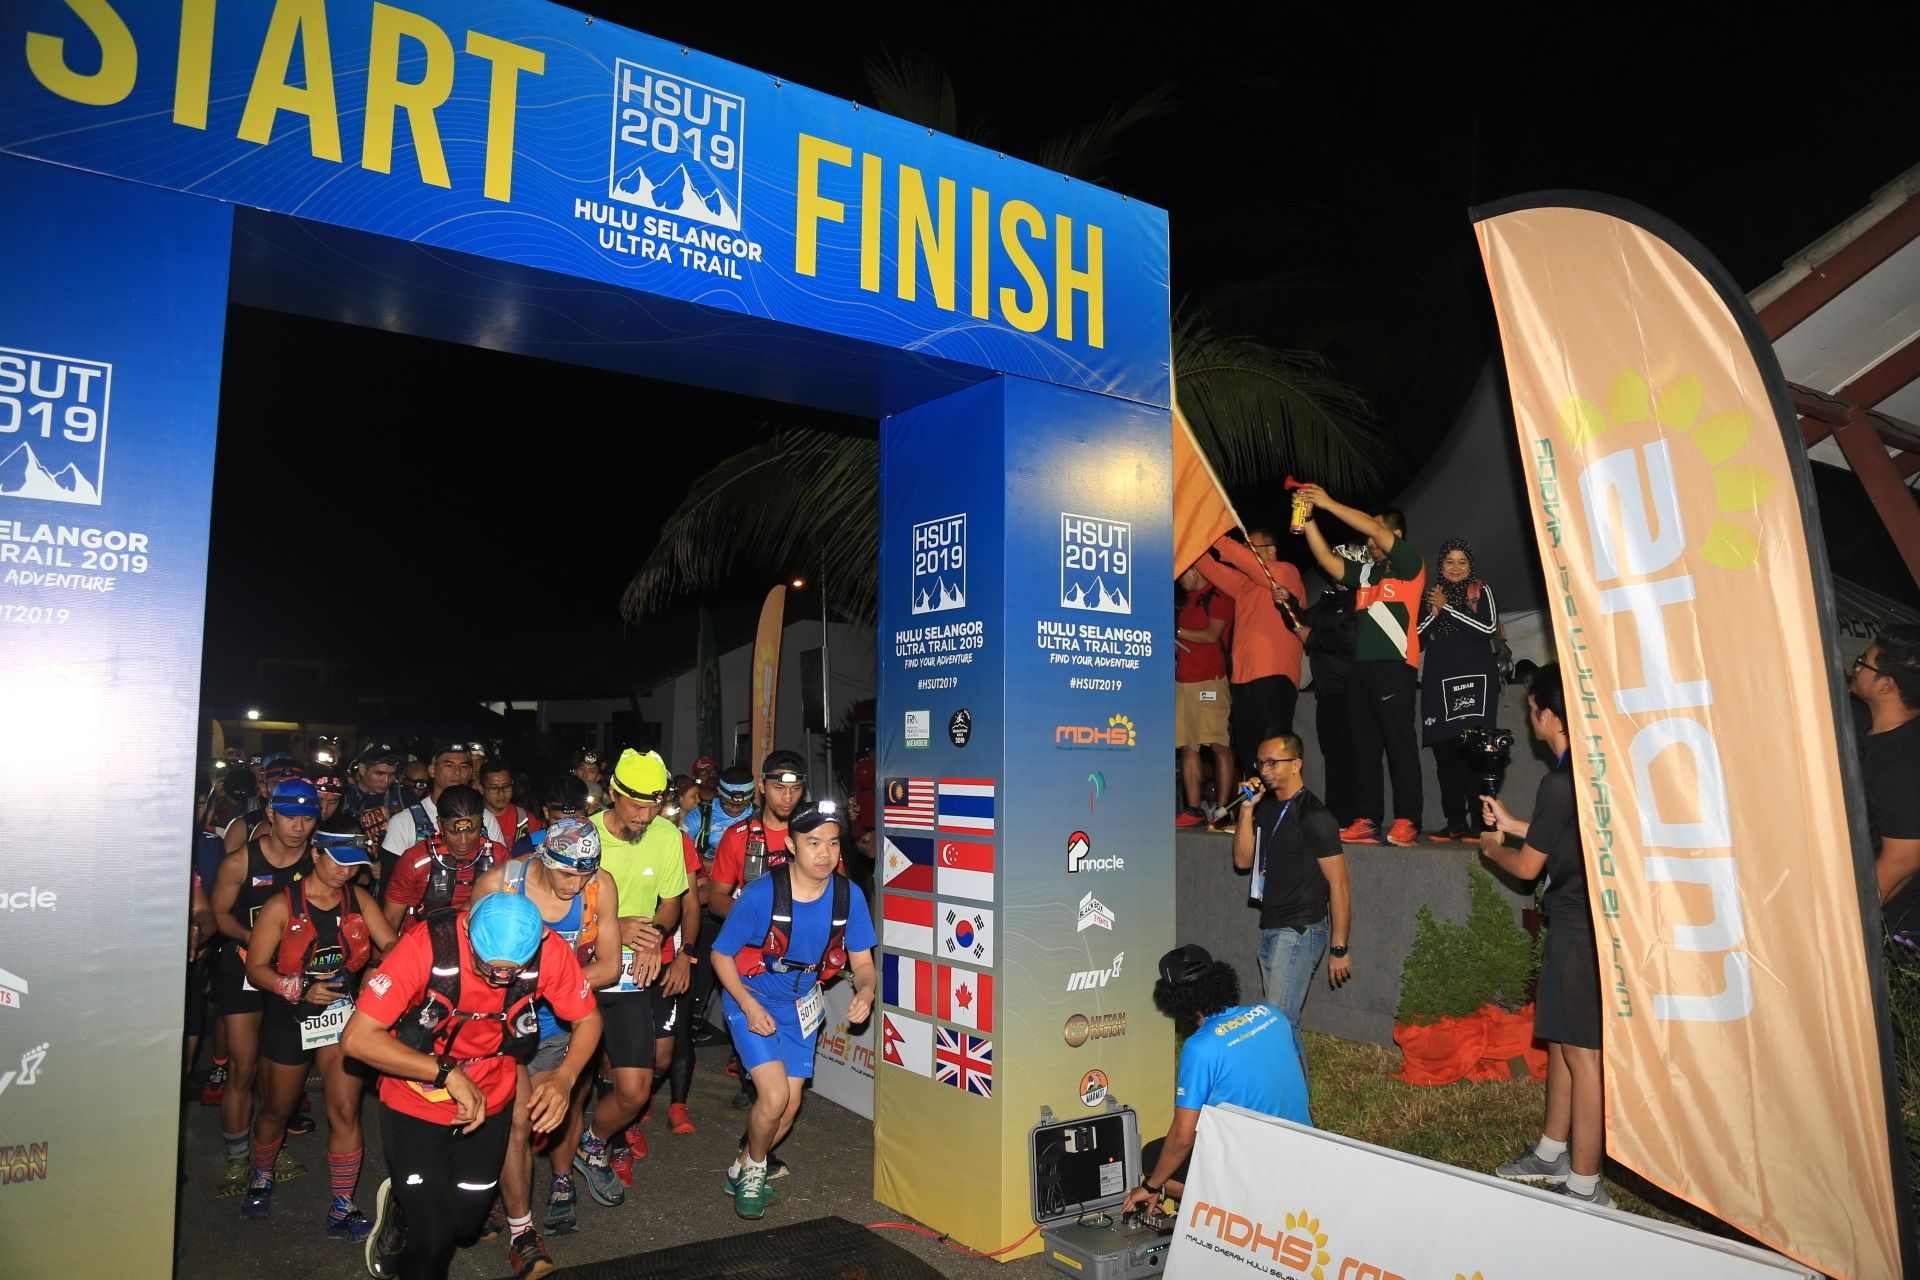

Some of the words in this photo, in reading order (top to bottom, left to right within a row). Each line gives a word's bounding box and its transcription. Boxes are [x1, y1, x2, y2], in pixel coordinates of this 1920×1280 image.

[25, 0, 546, 203] START
[621, 67, 737, 133] HSUT
[621, 108, 735, 171] 2019
[574, 198, 637, 231] HULU
[643, 215, 763, 264] SELANGOR
[795, 132, 1104, 349] FINISH
[599, 227, 672, 265] ULTRA
[680, 246, 743, 281] TRAIL
[915, 519, 963, 551] HSUT
[1065, 518, 1127, 550] HSUT
[81, 551, 148, 574] 2019
[916, 545, 963, 576] 2019
[1065, 545, 1127, 575] 2019
[5, 569, 116, 593] ADVENTURE
[896, 627, 922, 644] HULU
[925, 621, 983, 640] SELANGOR
[1037, 621, 1076, 637] HULU
[1079, 625, 1152, 644] SELANGOR
[896, 642, 925, 656] ULTRA
[928, 638, 957, 653] TRAIL
[960, 635, 983, 650] 2019
[1037, 635, 1079, 650] ULTRA
[1083, 639, 1121, 655] TRAIL
[1124, 643, 1152, 657] 2019
[905, 658, 918, 669] FIND
[919, 656, 936, 668] YOUR
[937, 653, 973, 667] ADVENTURE
[1050, 653, 1070, 664] FIND
[1071, 654, 1093, 667] YOUR
[1094, 657, 1140, 670] ADVENTURE
[917, 677, 958, 690] #HSUT2019
[1070, 677, 1122, 691] #HSUT2019
[1056, 726, 1127, 745] MDHS
[304, 1011, 344, 1031] 50301
[1189, 1201, 1313, 1272] MDHS
[1246, 1260, 1268, 1274] HULU
